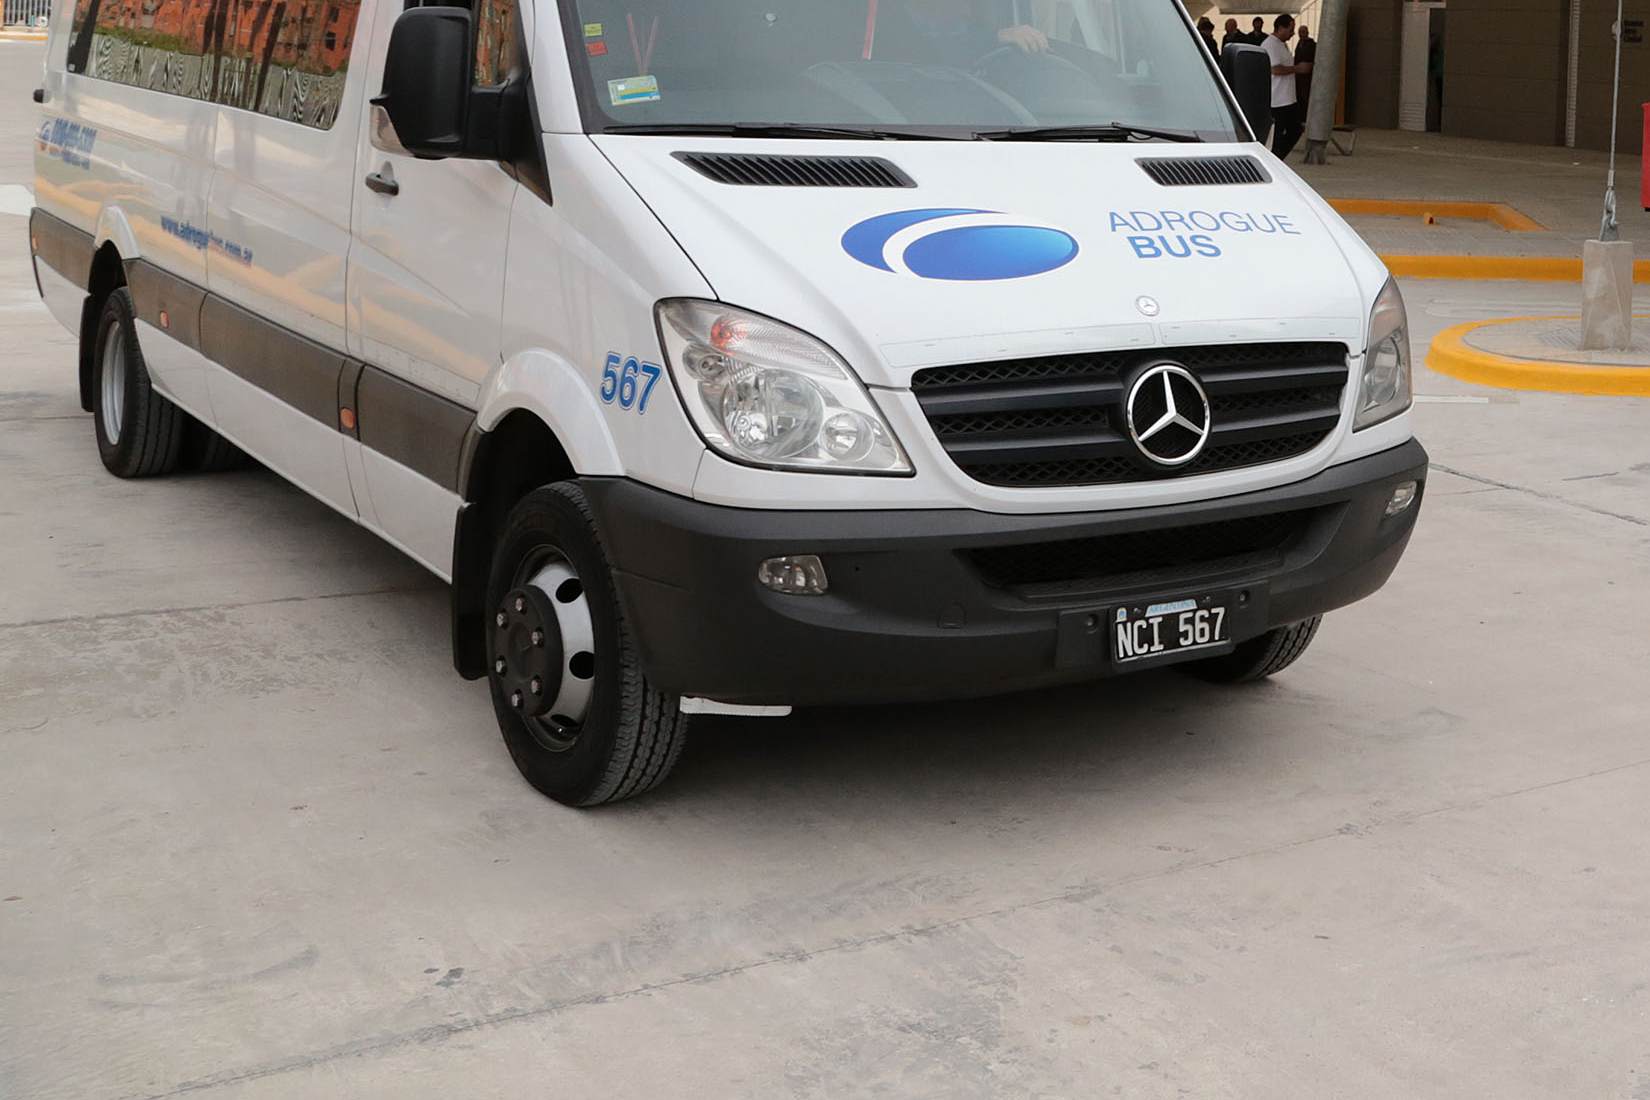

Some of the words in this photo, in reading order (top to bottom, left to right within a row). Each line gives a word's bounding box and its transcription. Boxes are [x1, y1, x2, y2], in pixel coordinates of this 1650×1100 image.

[1109, 210, 1301, 235] ADROGUE
[1127, 234, 1222, 259] BUS
[600, 351, 662, 415] 567
[1117, 617, 1164, 658] NCI
[1179, 607, 1225, 646] 567
